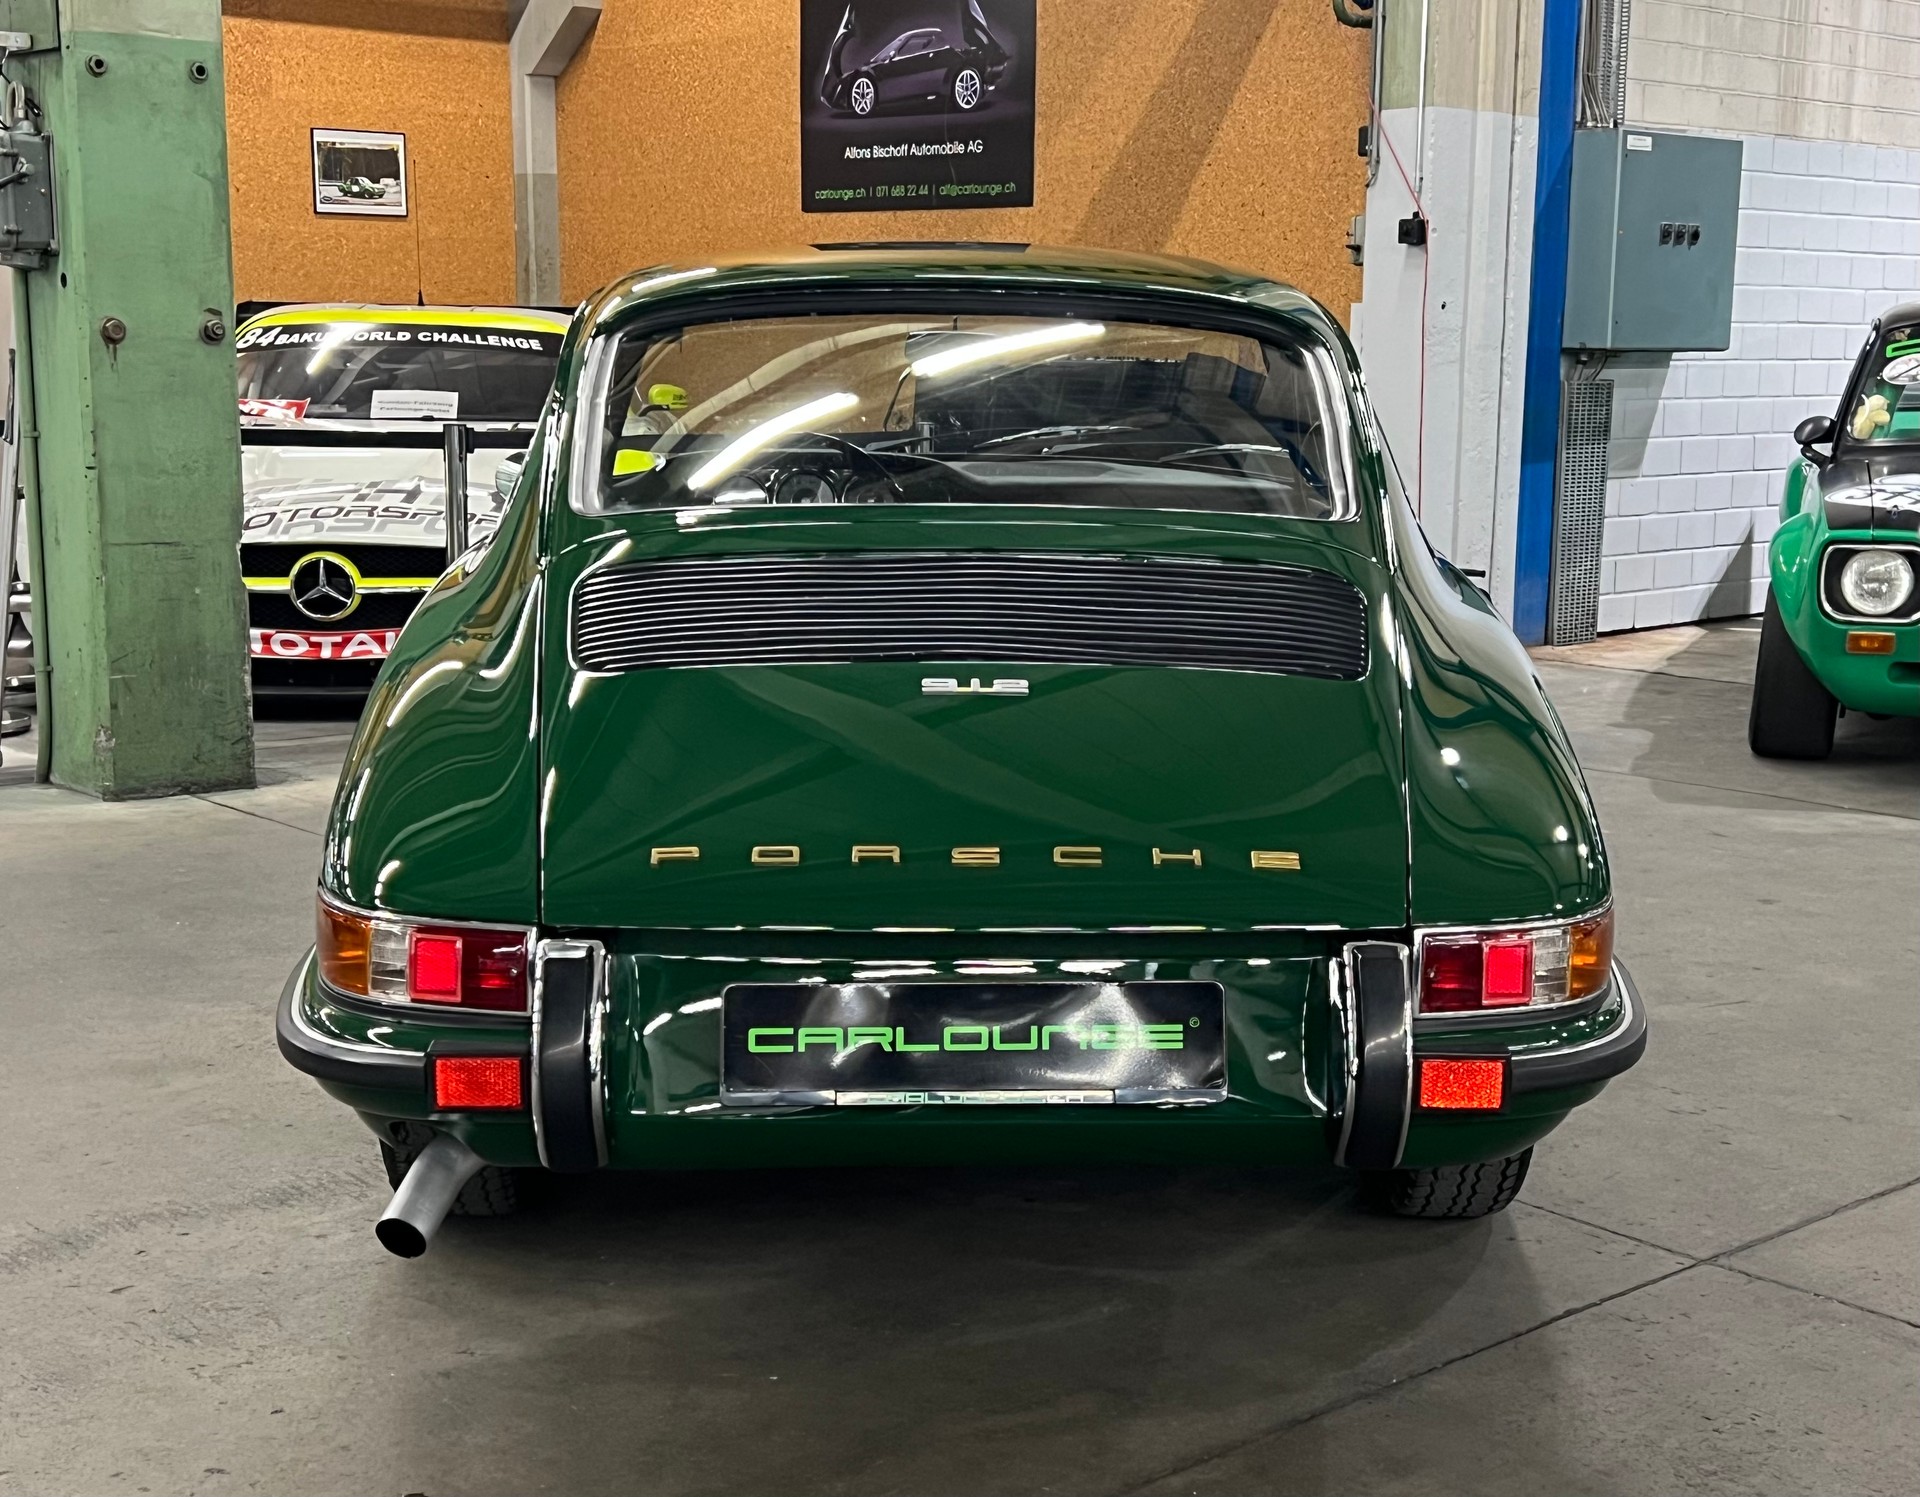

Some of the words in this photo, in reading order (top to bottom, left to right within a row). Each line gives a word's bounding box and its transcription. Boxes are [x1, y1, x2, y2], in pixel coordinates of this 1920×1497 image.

[844, 146, 871, 159] Alfons
[872, 144, 908, 158] Bischoff
[910, 141, 964, 156] Automobile
[967, 140, 983, 153] AG
[815, 187, 866, 200] carlounge.ch
[876, 186, 889, 198] 071
[907, 184, 917, 196] 22
[918, 184, 929, 196] 44
[939, 181, 1016, 196] alf@carlounge.ch
[340, 331, 411, 341] ORLD
[418, 331, 543, 351] CHALLENGE
[921, 678, 1029, 696] 912
[650, 845, 1301, 869] PORSCHE
[748, 1024, 1184, 1053] CARLOUNGE
